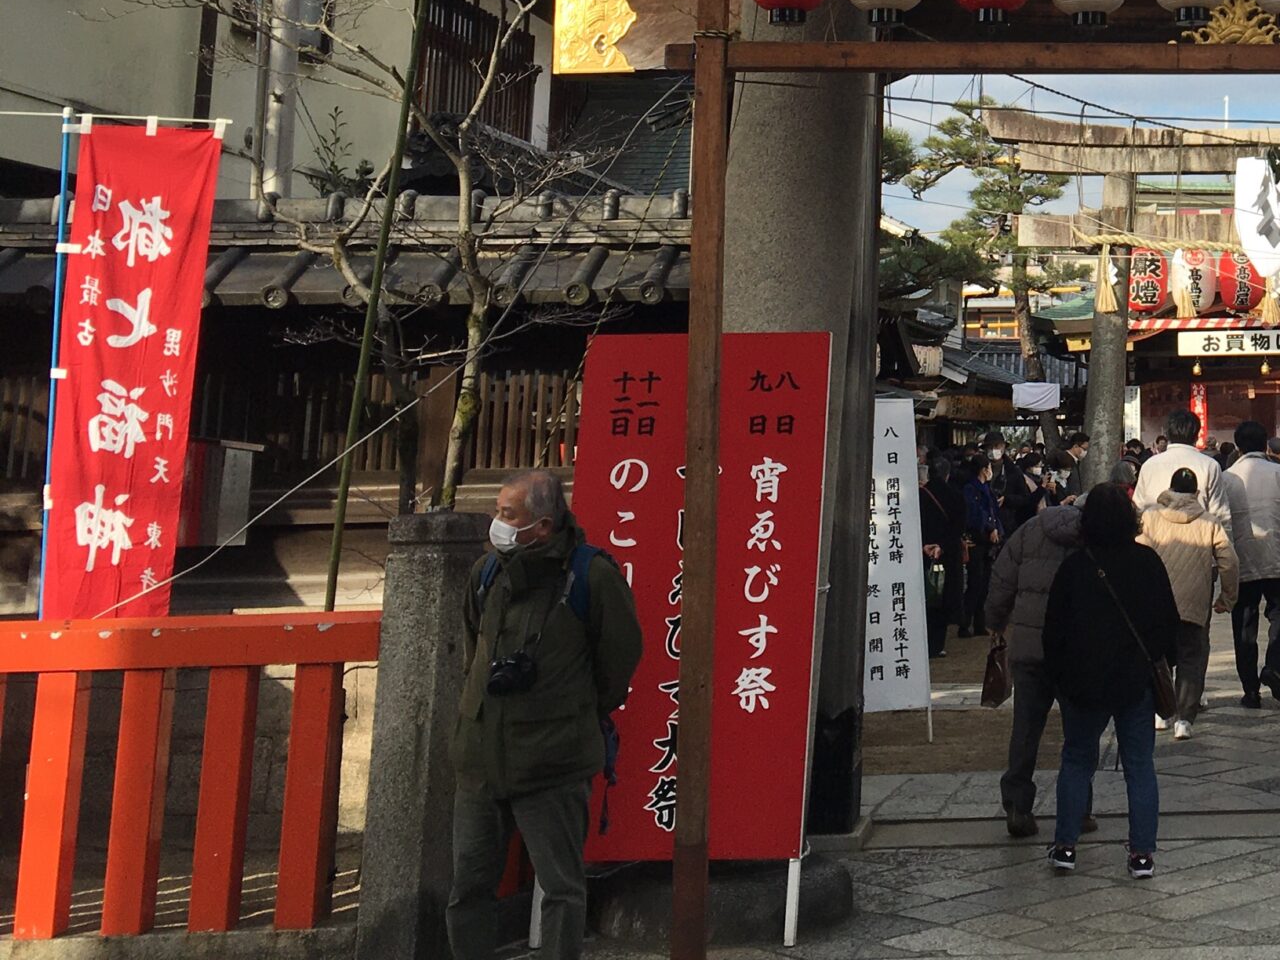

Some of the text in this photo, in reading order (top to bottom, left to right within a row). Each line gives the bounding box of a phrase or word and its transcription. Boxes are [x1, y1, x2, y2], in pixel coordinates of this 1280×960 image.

[611, 372, 633, 437] 十二日
[637, 372, 661, 437] 十一日
[747, 372, 773, 436] 九日
[776, 372, 799, 436] 八日
[886, 477, 904, 564] 開門午前九時
[731, 458, 788, 713] 宵ゑびす祭
